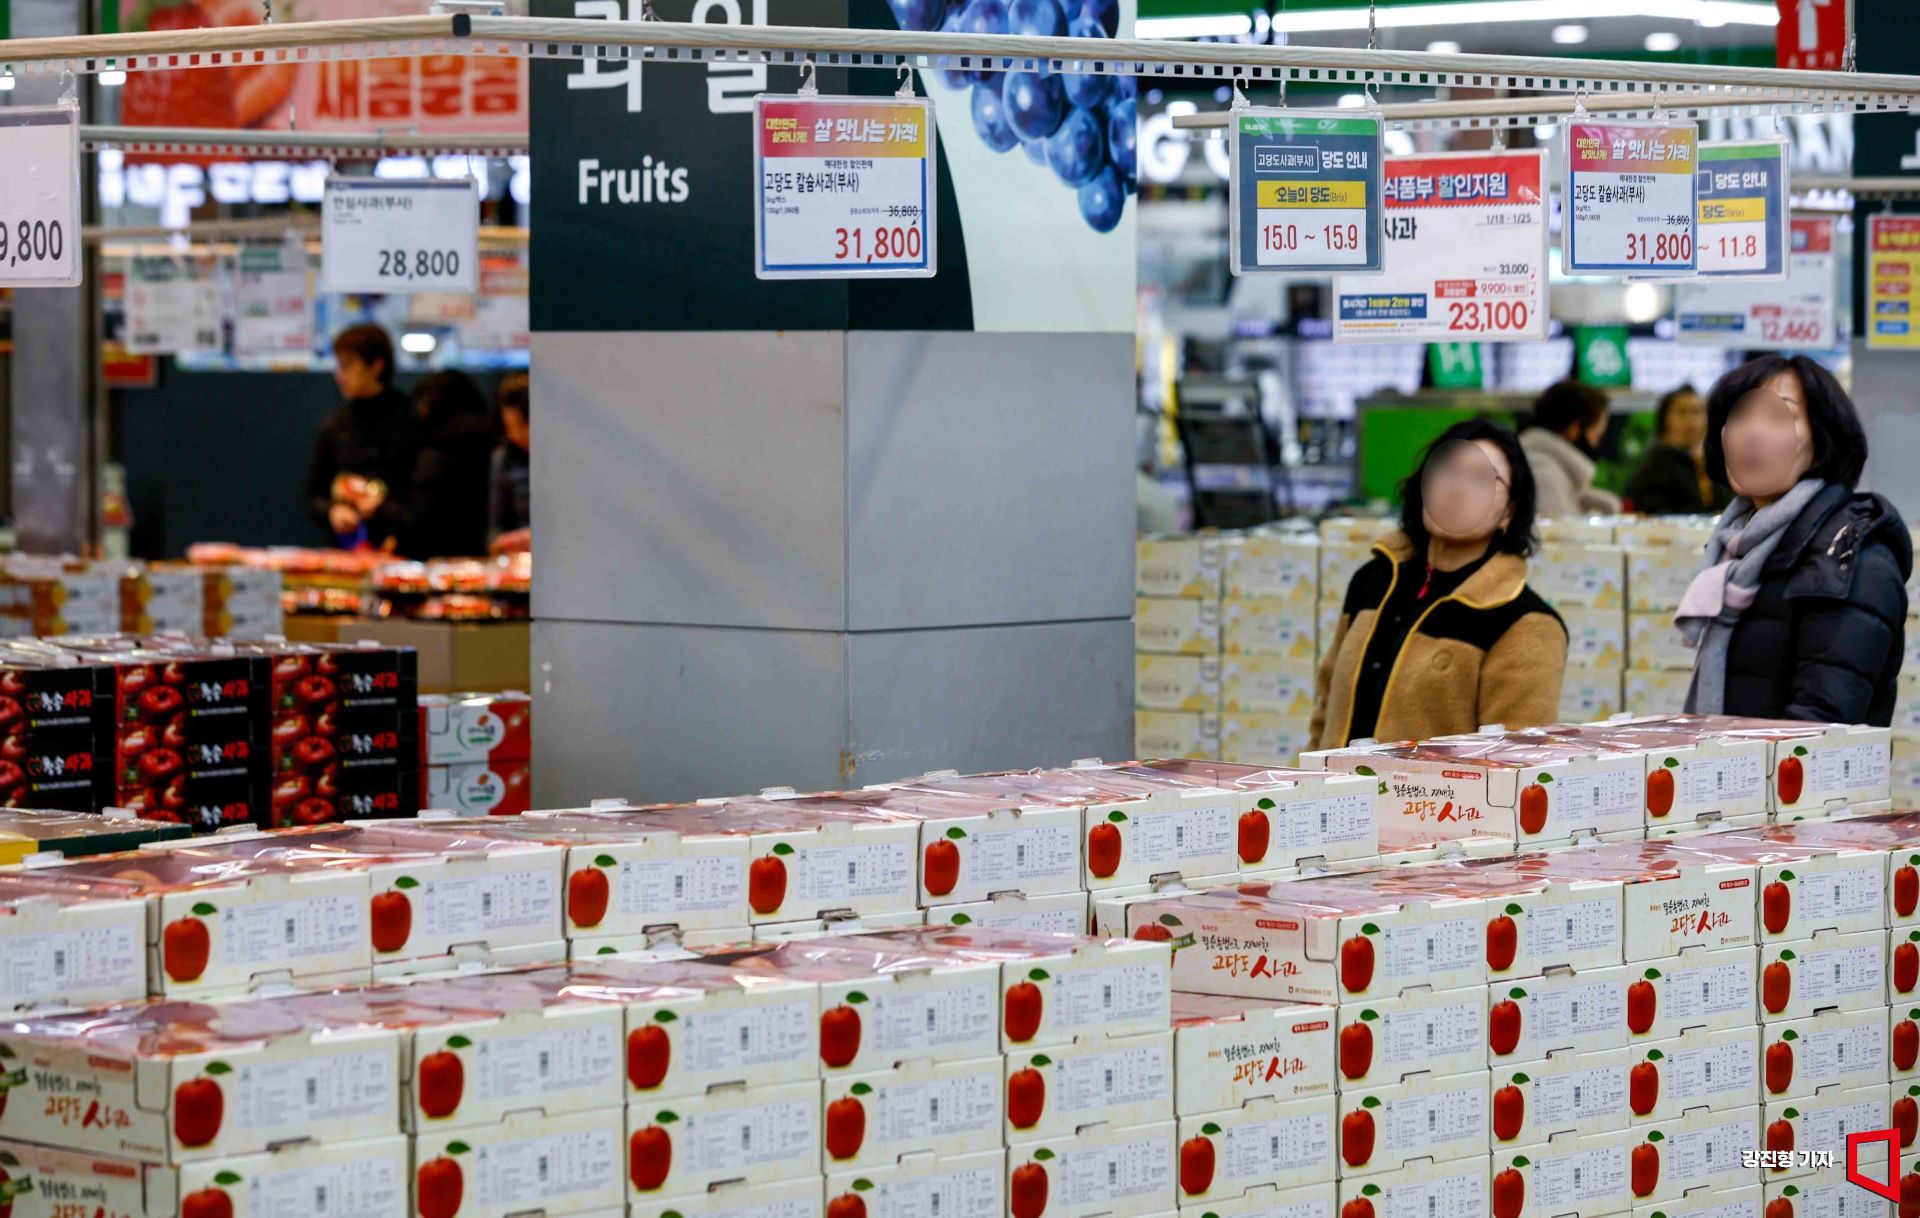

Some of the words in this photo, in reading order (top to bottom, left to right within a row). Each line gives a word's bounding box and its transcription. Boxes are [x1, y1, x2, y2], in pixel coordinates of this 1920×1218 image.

[765, 118, 798, 130] 대한민국
[814, 119, 833, 143] 살
[836, 118, 886, 143] 맛나는
[1257, 153, 1314, 168] 고당도사과(부사)
[1321, 151, 1344, 169] 당도
[1346, 151, 1368, 169] 안내
[1613, 139, 1625, 160] 살
[1628, 139, 1665, 160] 맛나는
[579, 155, 689, 205] Fruits
[765, 173, 793, 193] 고당도
[796, 172, 860, 194] 칼슘사과(부사)
[1438, 172, 1509, 199] 할인지원
[1715, 173, 1739, 190] 당도
[1742, 171, 1767, 189] 안내
[1276, 187, 1308, 203] 오늘의
[1575, 185, 1596, 203] 고당도
[1598, 184, 1645, 204] 칼슘사과(부사)
[888, 205, 918, 218] 36,800
[1487, 214, 1505, 225] 1/18
[1513, 213, 1532, 224] 1/25
[1666, 215, 1690, 226] 36,800
[834, 226, 921, 264] 31,800
[1263, 224, 1297, 250] 15.0
[1323, 224, 1358, 250] 15.9
[1626, 232, 1692, 264] 31,800
[1719, 235, 1757, 257] 11.8
[378, 250, 460, 280] 28,800
[1449, 300, 1528, 333] 23,100
[1403, 800, 1437, 822] 고당도
[1437, 801, 1485, 822] 사과
[1670, 912, 1697, 937] 고당도
[1696, 910, 1732, 934] 사과
[1212, 953, 1249, 978] 고당도
[1250, 955, 1302, 979] 사과
[1232, 1059, 1264, 1086] 고당도
[1264, 1056, 1308, 1082] 사과
